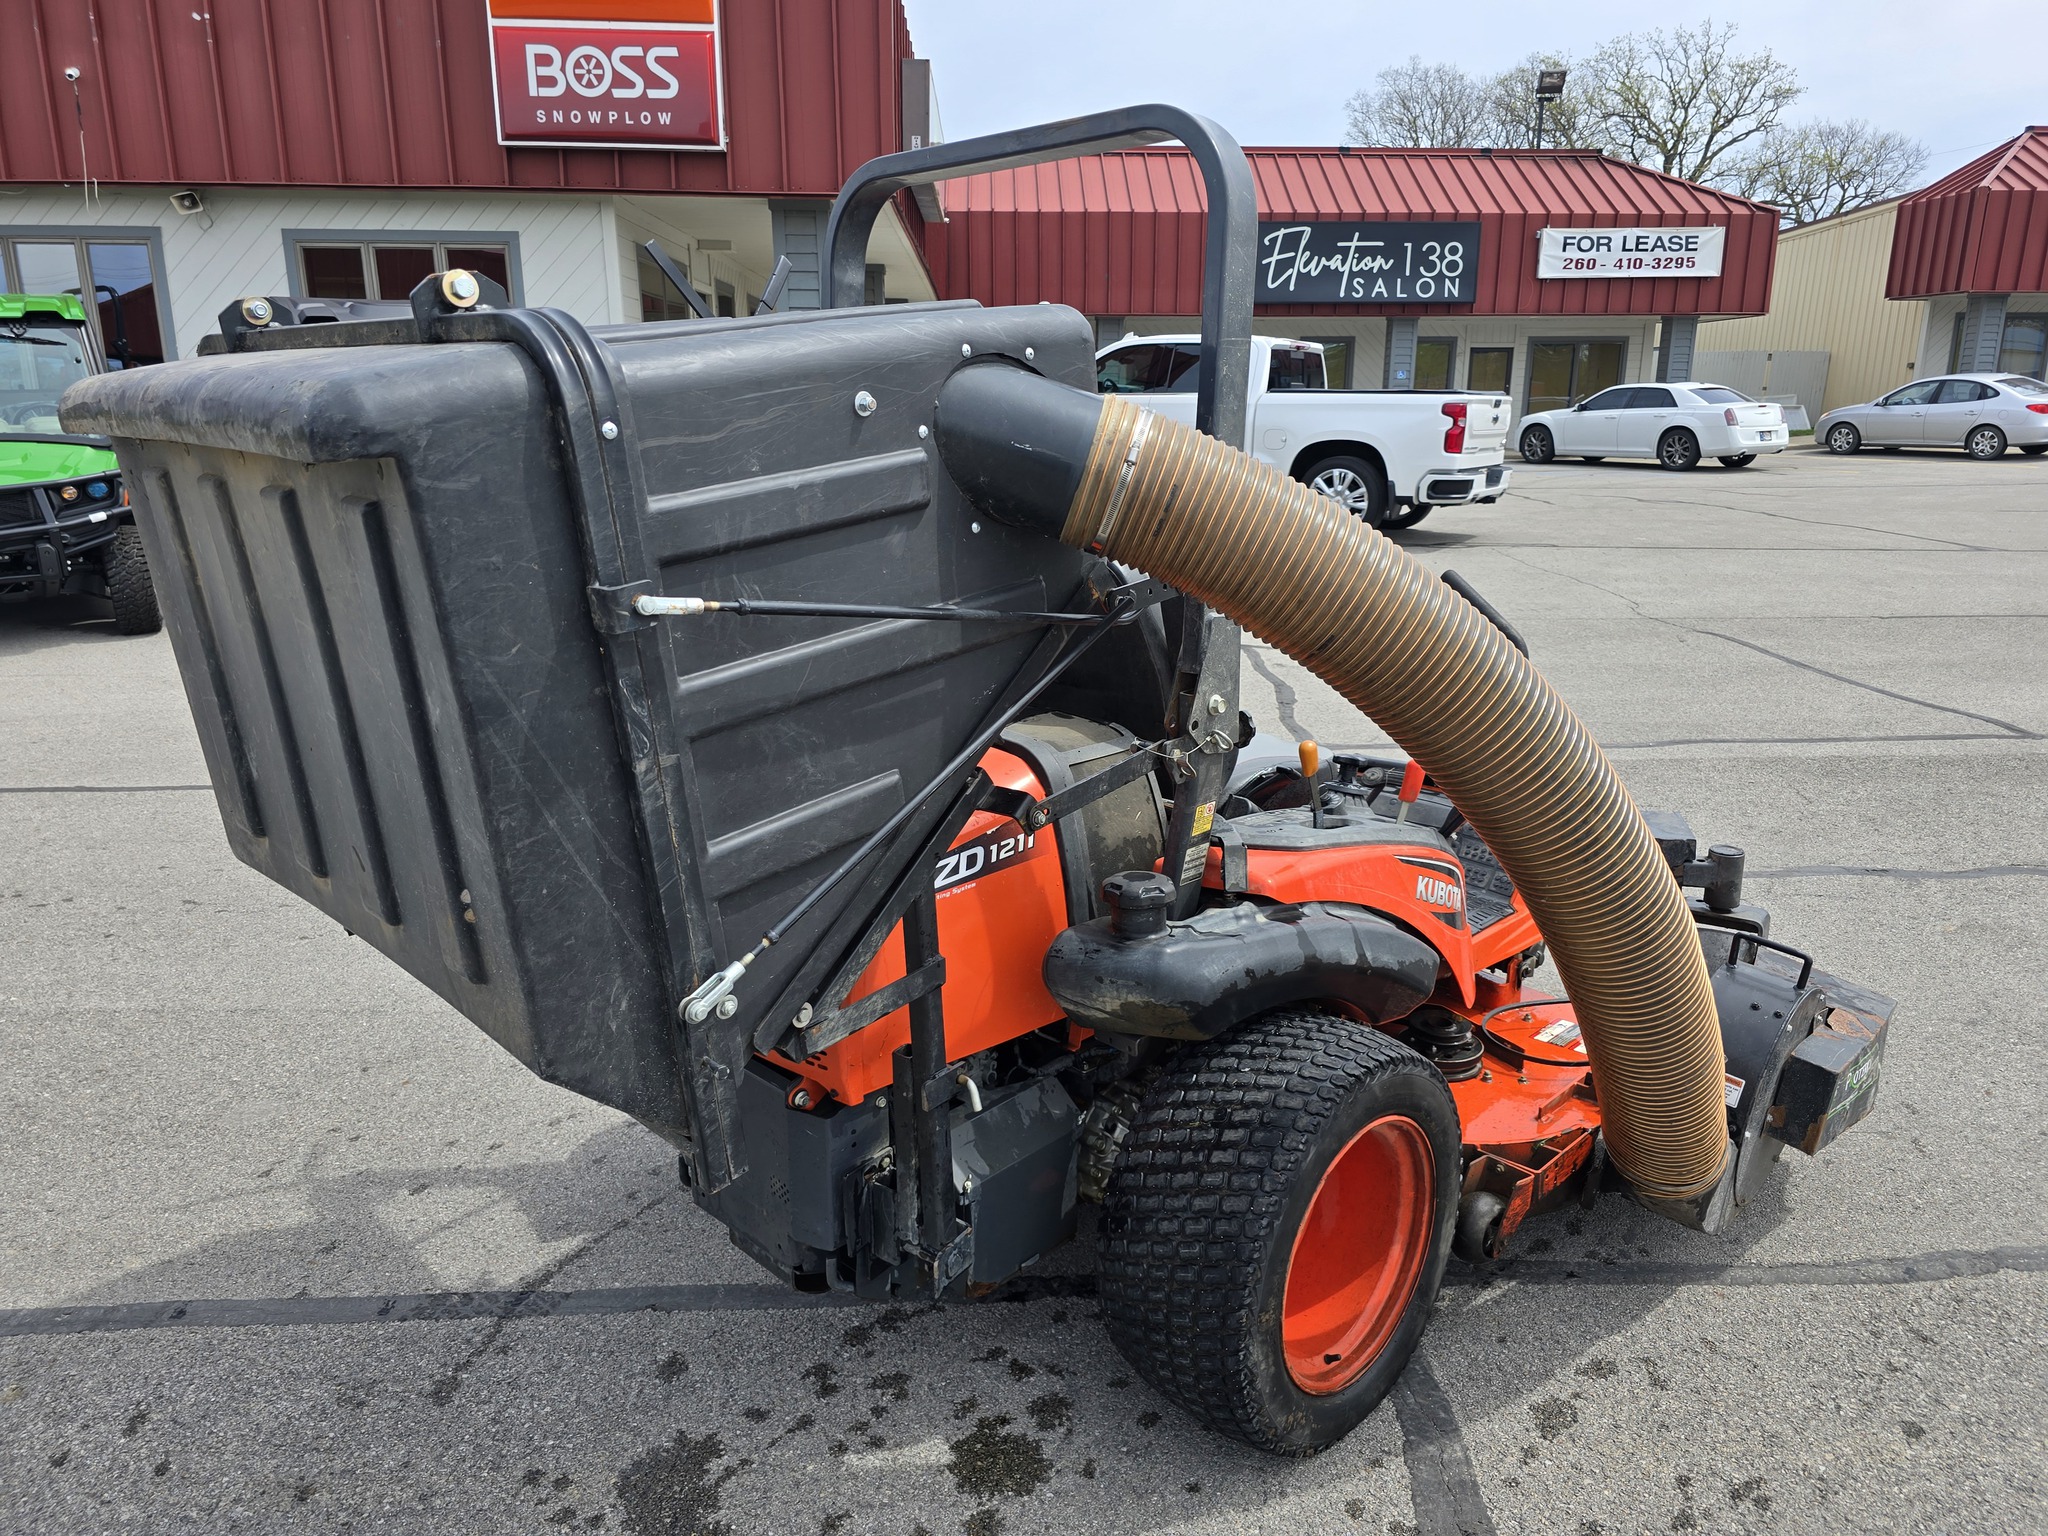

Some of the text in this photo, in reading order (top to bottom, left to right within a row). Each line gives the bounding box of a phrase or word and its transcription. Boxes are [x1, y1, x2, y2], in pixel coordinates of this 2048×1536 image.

[525, 43, 679, 99] BOSS
[536, 109, 672, 125] SNOWPLOW
[1562, 235, 1699, 252] FOR LEASE
[1262, 226, 1464, 298] Elevation 138
[1352, 277, 1460, 298] SALON
[934, 845, 985, 888] ZD
